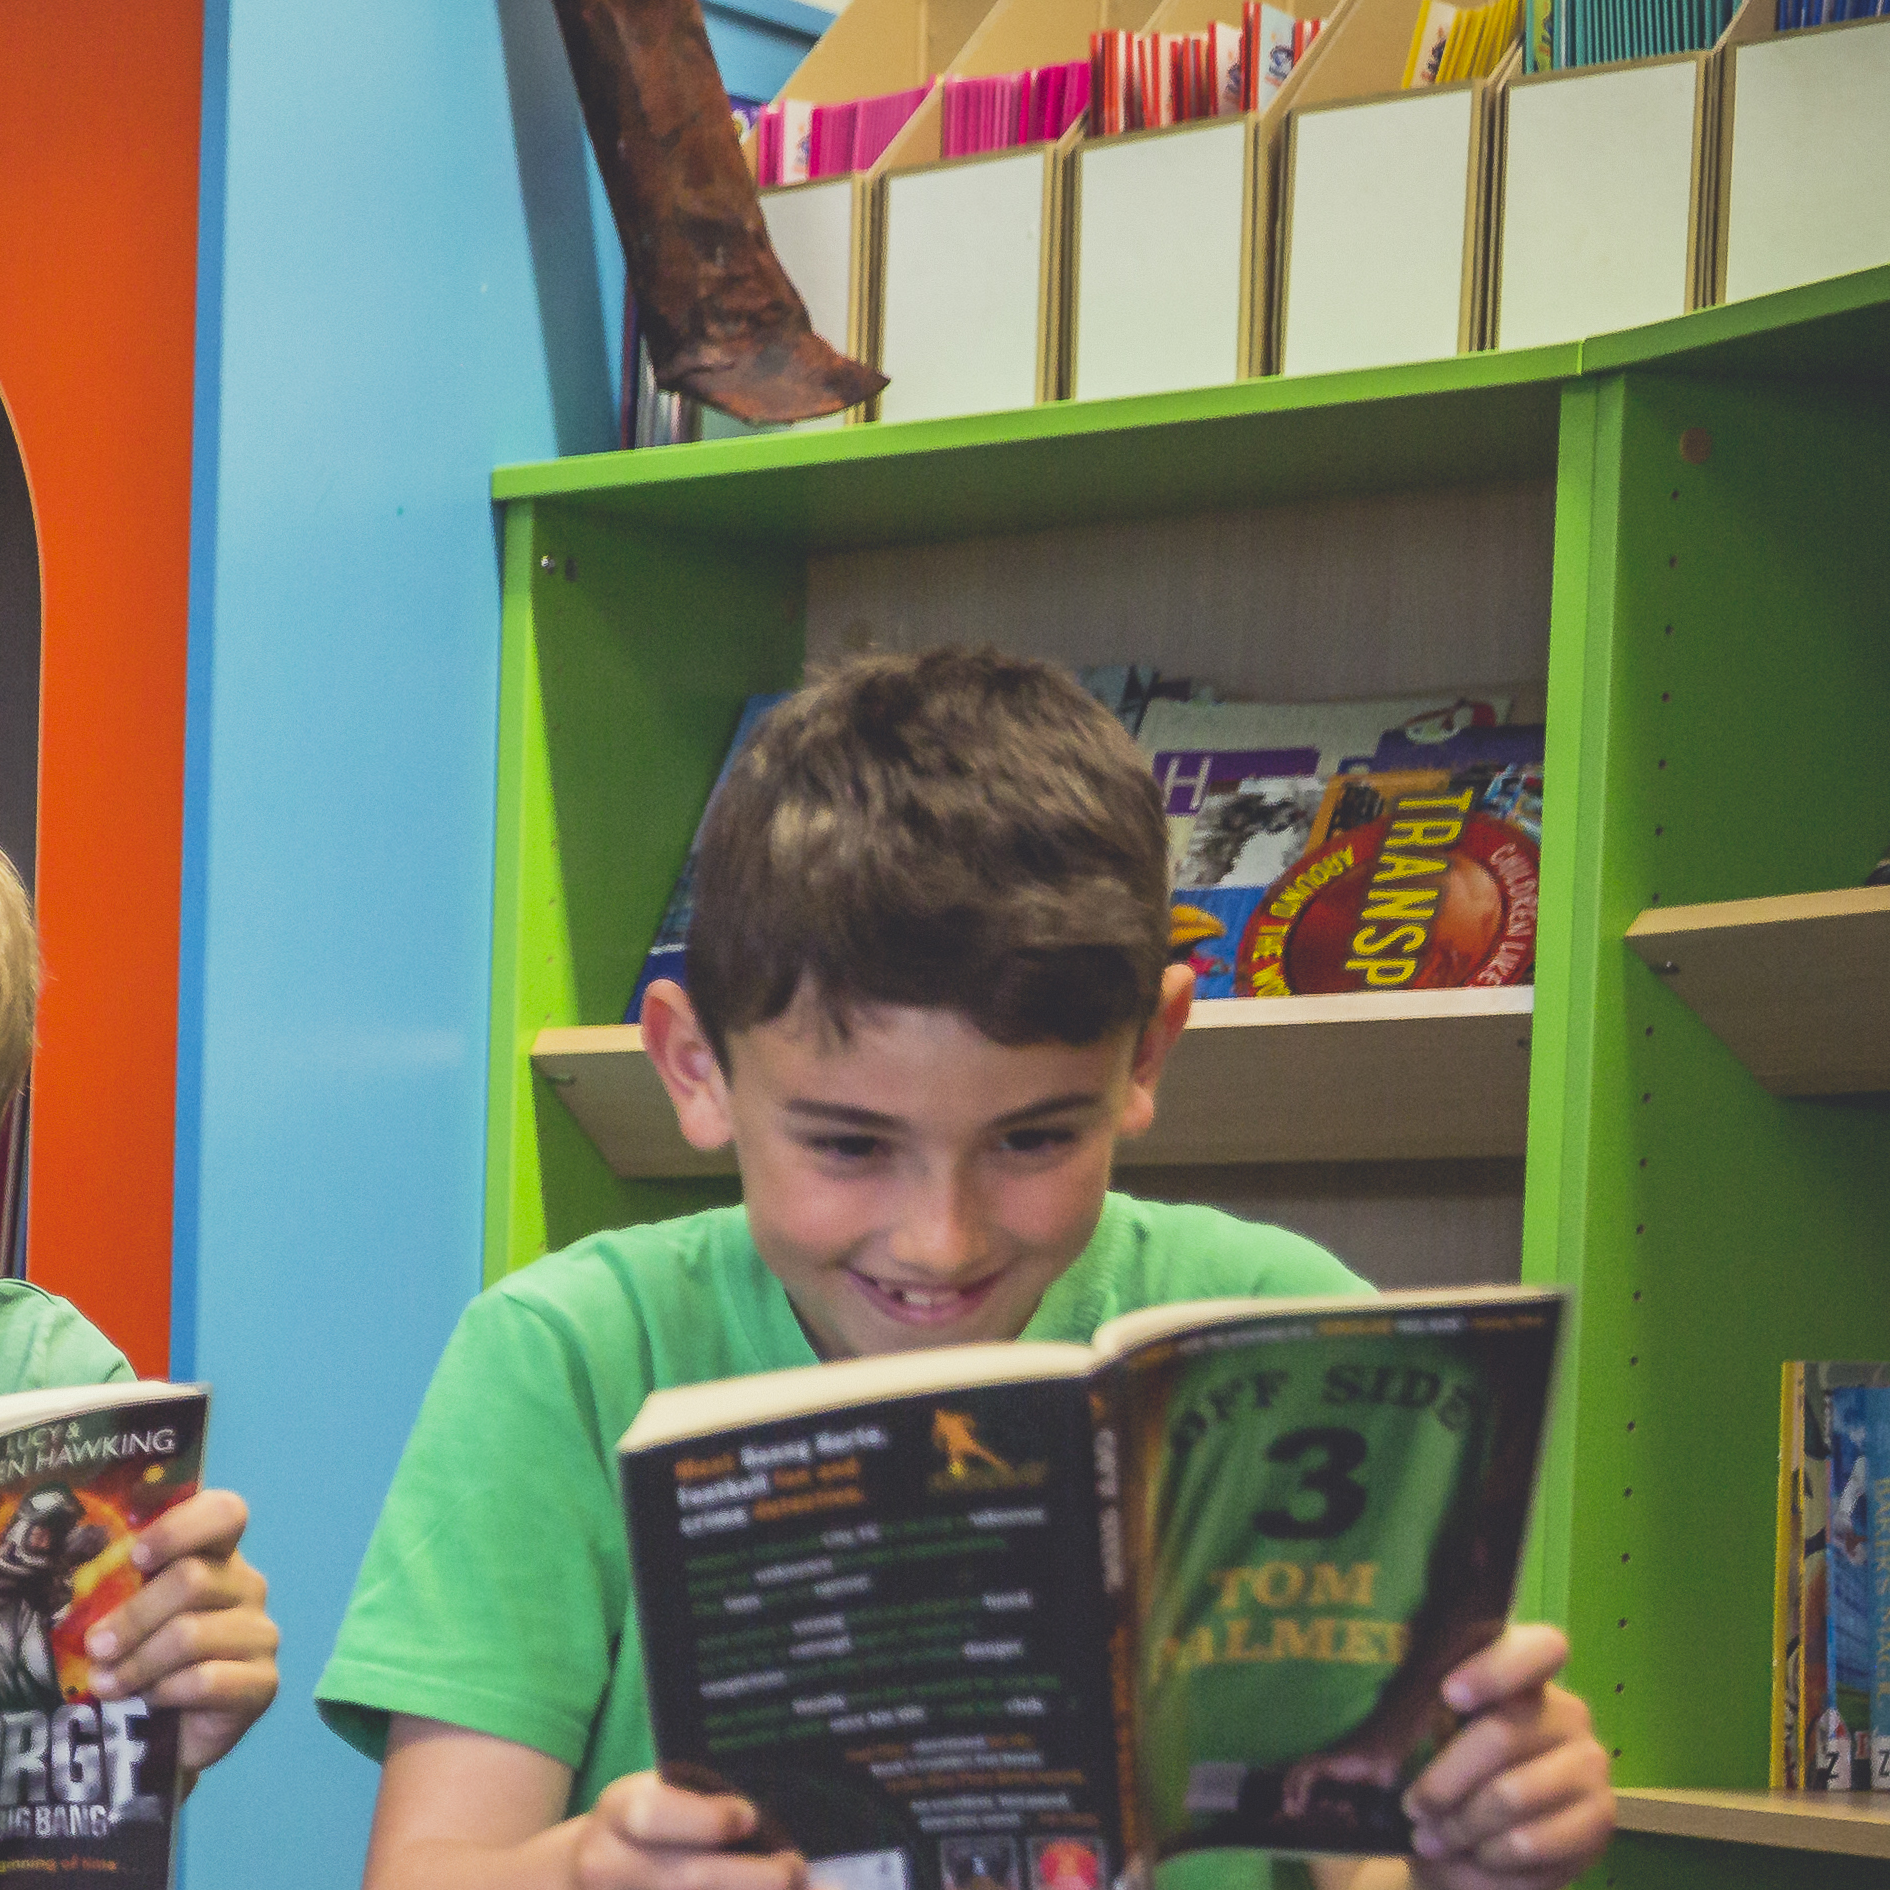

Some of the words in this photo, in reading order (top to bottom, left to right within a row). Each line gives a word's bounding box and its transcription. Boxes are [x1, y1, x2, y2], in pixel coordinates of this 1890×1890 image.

[1345, 787, 1475, 987] TRANSP
[35, 1427, 176, 1473] HAWKING
[1252, 1426, 1368, 1541] 3
[1209, 1560, 1384, 1610] TOM
[34, 1804, 108, 1838] BANG
